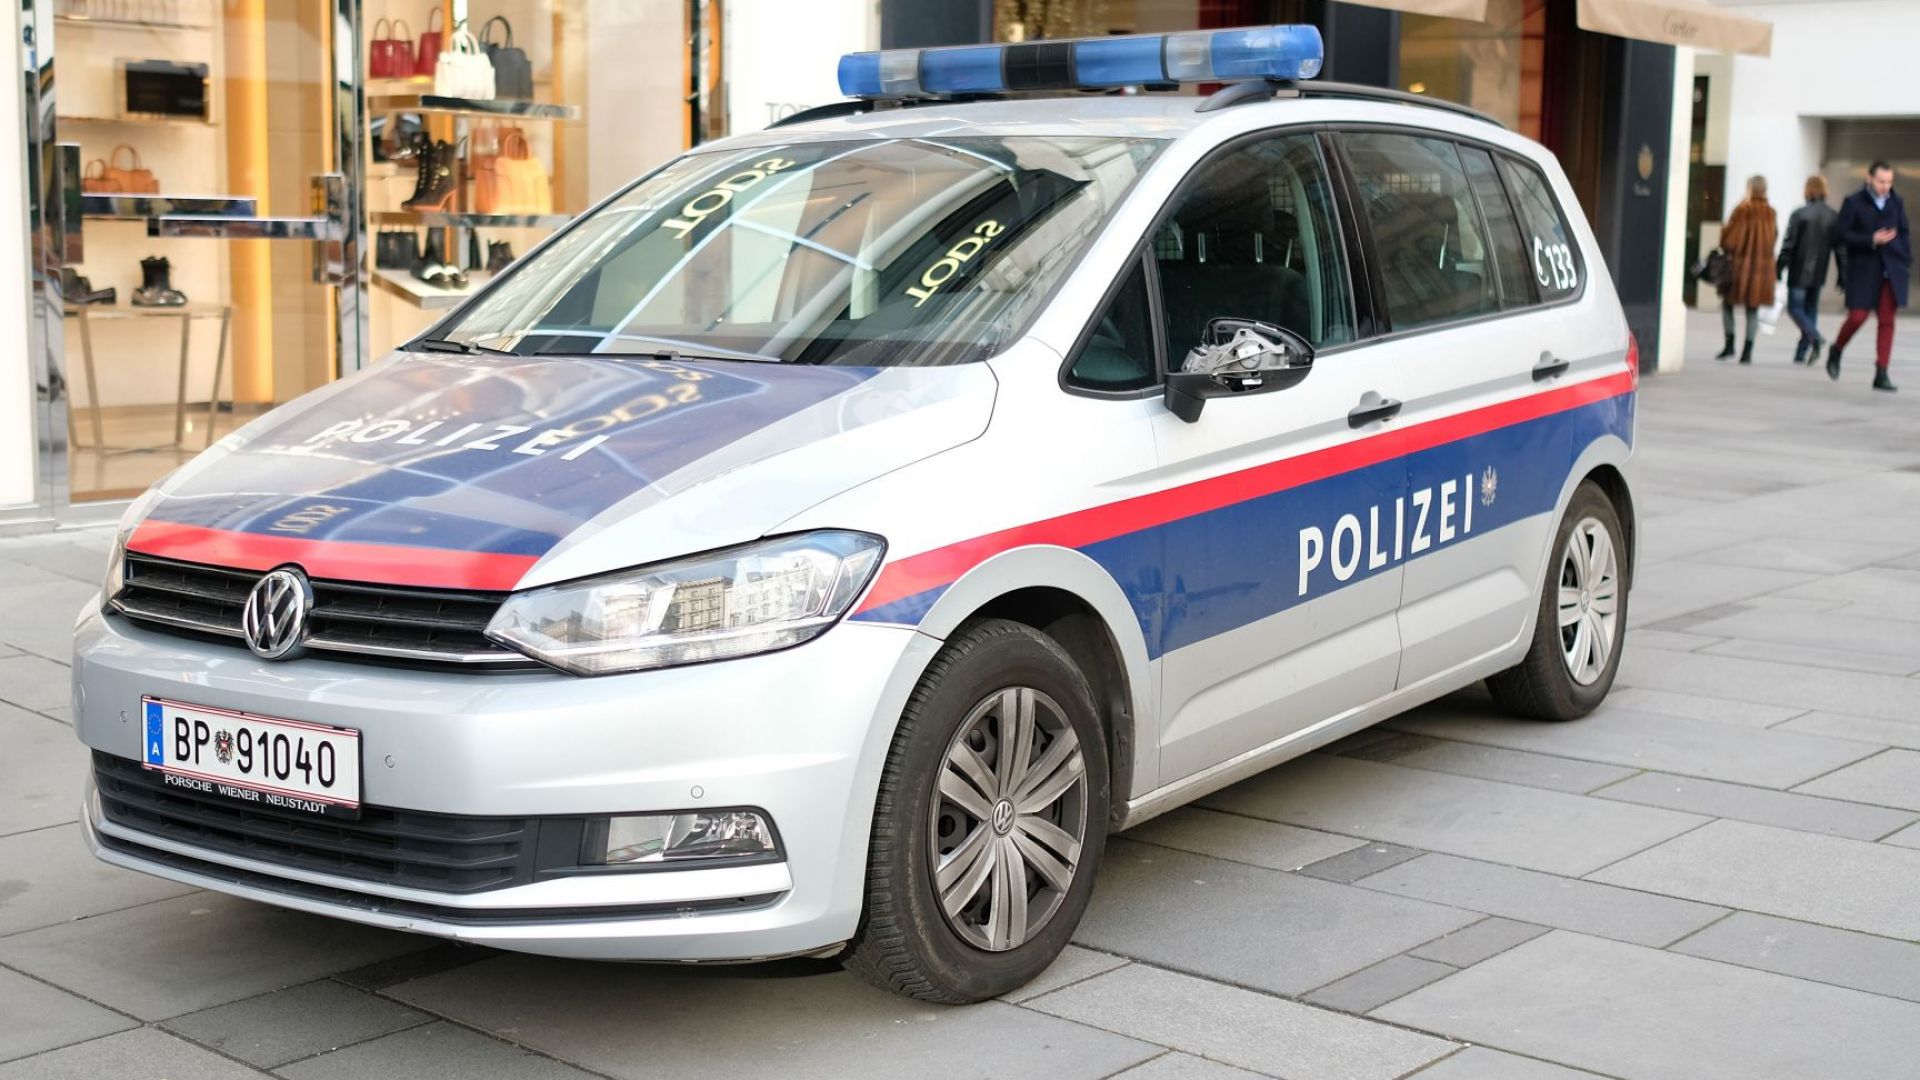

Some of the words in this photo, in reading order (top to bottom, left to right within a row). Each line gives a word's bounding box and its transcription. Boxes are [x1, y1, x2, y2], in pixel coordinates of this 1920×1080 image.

[1545, 244, 1577, 290] 133
[304, 418, 610, 461] POLIZEI
[1299, 473, 1473, 596] POLIZEI
[152, 742, 160, 756] A
[175, 717, 210, 765] BP
[237, 728, 335, 788] 91040
[165, 775, 212, 792] PORSCHE
[219, 785, 259, 801] WIENER
[266, 794, 327, 814] NEUSTADT
